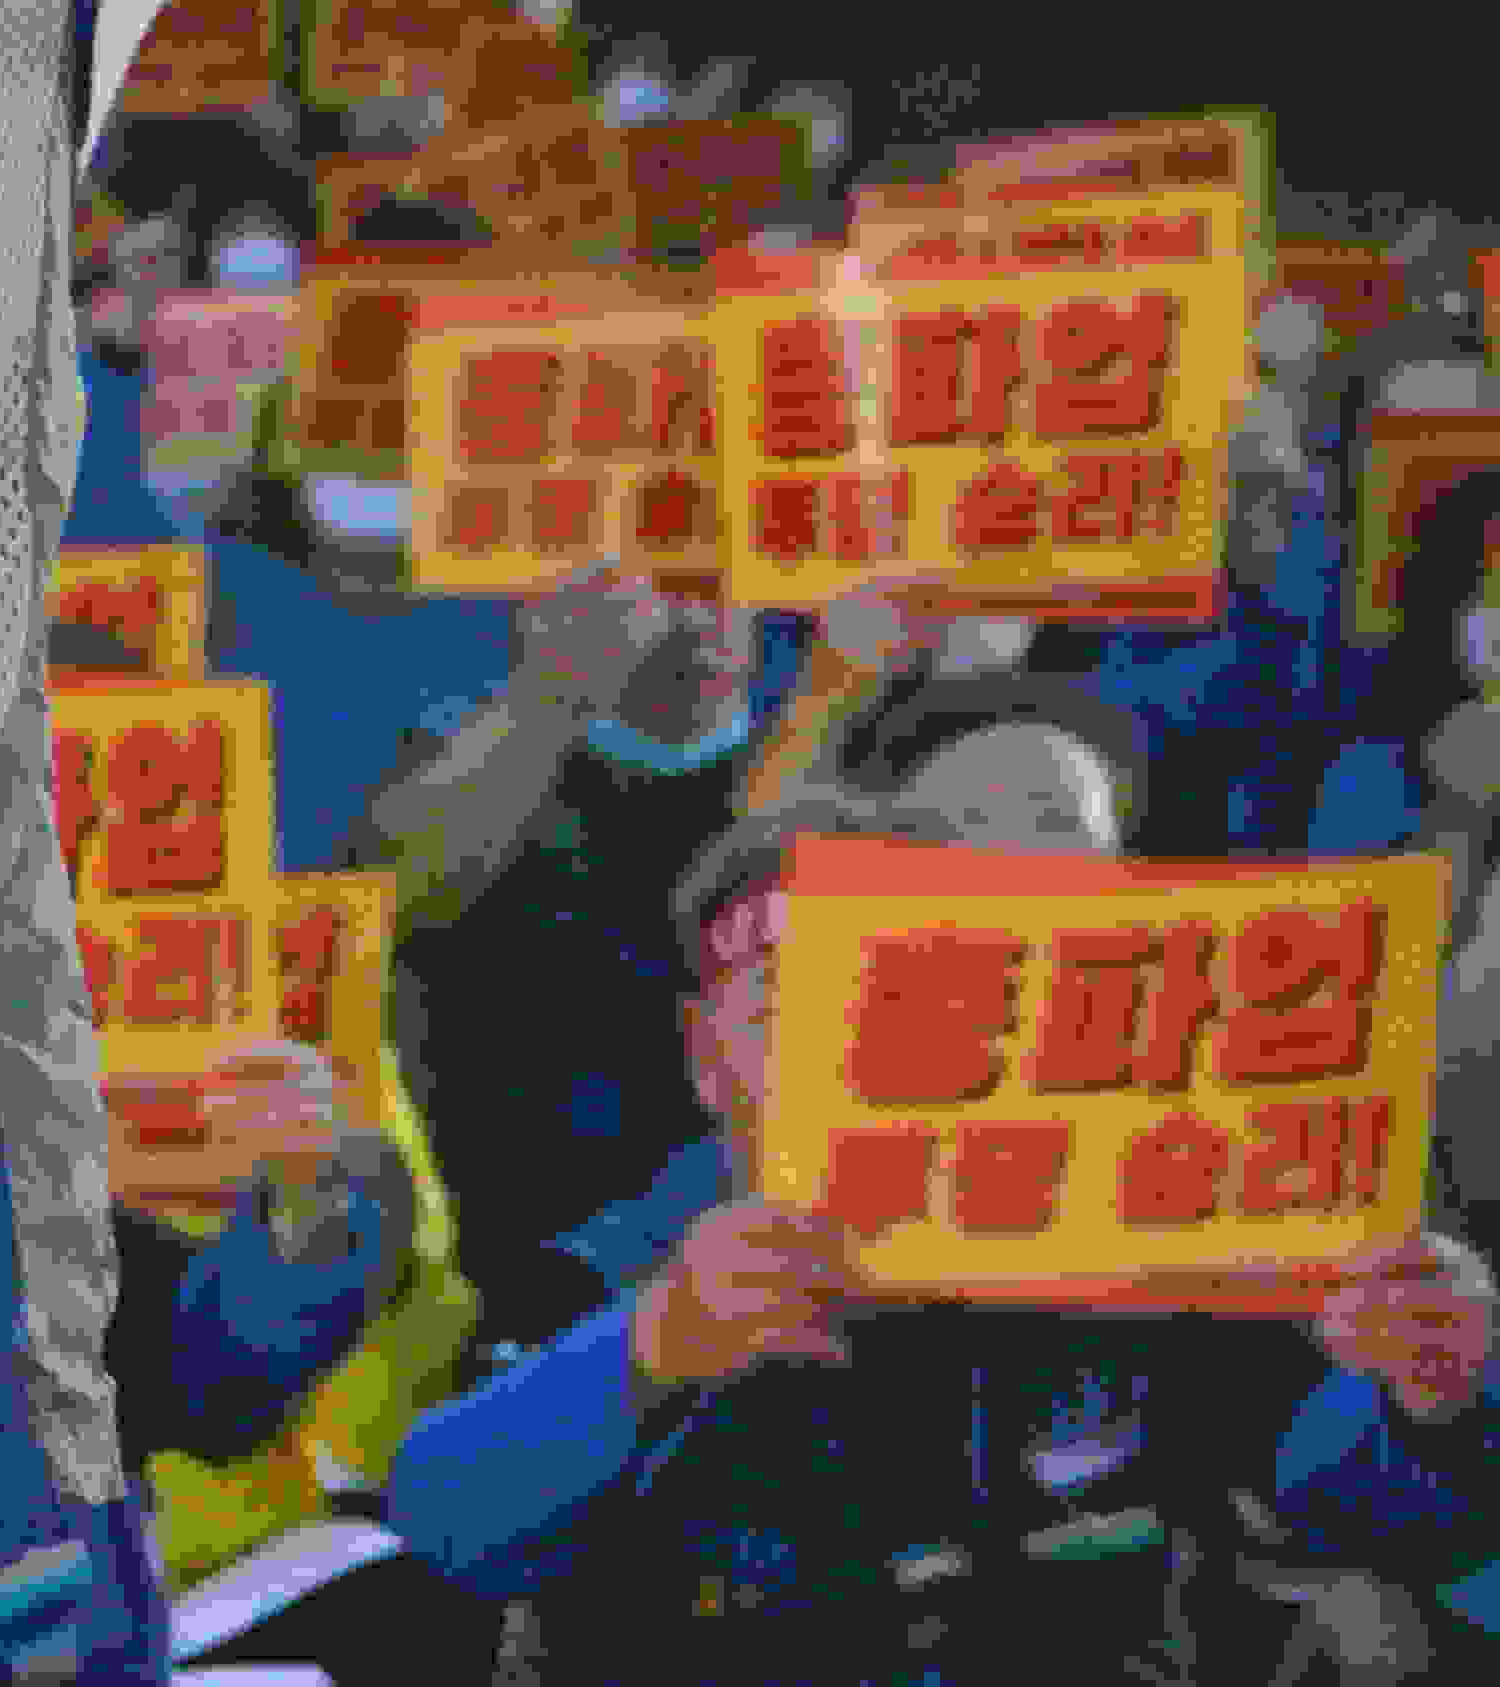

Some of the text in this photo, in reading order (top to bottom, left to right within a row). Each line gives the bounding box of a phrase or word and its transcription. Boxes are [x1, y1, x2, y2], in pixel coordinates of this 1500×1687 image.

[759, 292, 1176, 460] 총파업
[842, 896, 1388, 1108] 총파업
[1115, 1092, 1393, 1228] 승리!
